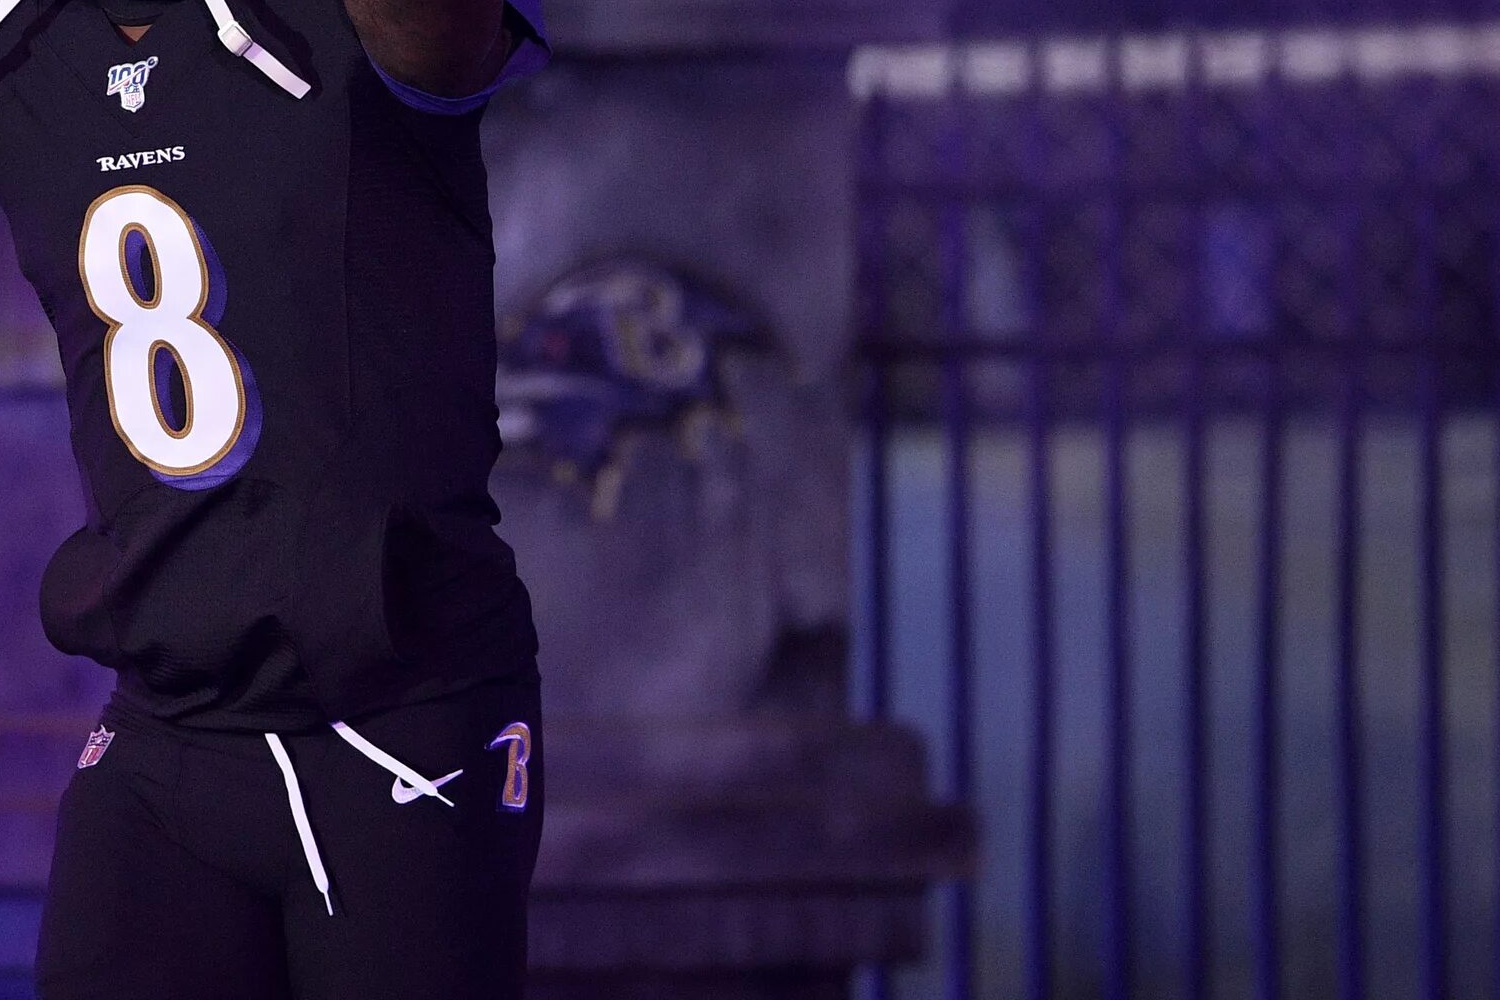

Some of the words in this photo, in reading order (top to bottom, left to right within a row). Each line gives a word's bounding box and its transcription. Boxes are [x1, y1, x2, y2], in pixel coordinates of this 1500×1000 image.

[109, 64, 149, 86] 100
[96, 146, 185, 171] RAVENS
[78, 184, 255, 484] 8
[489, 722, 531, 808] B
